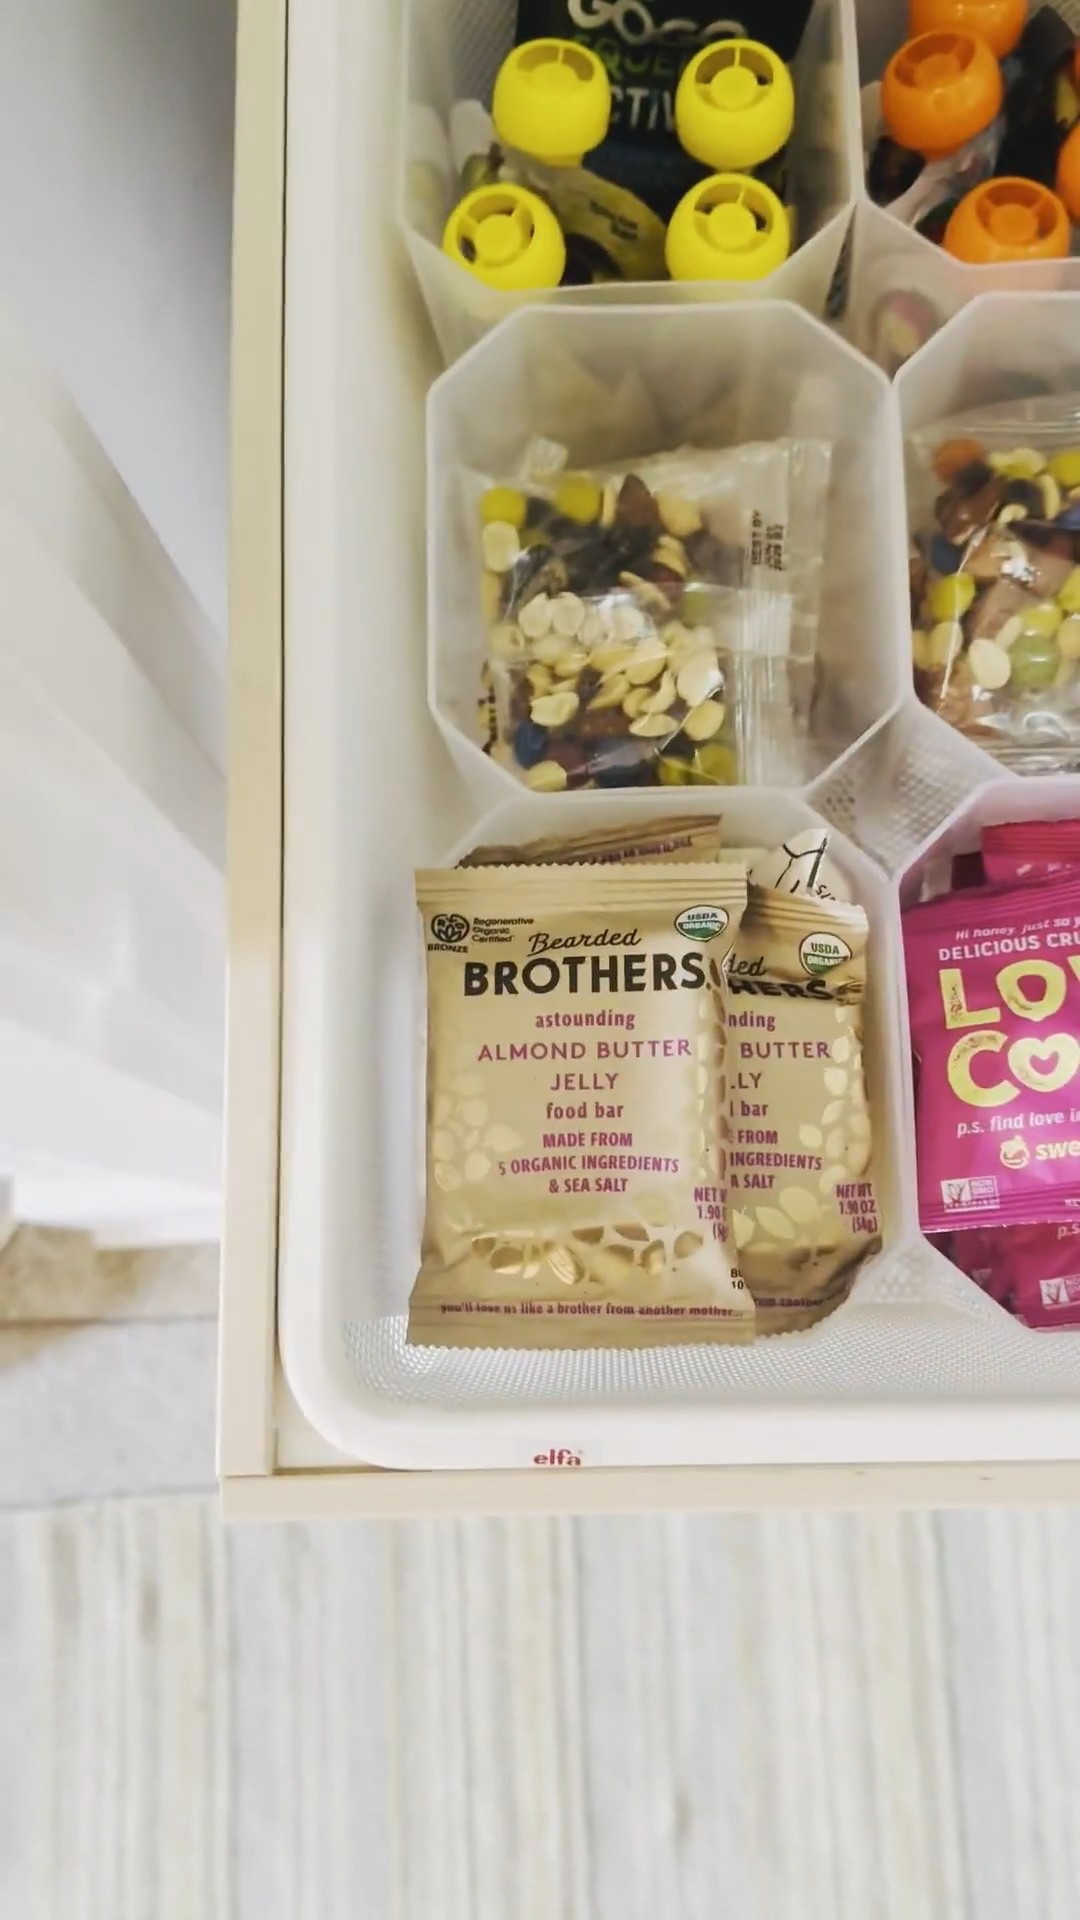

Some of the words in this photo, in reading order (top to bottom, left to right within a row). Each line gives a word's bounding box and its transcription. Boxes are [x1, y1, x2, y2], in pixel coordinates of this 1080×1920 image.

[473, 917, 534, 927] Regenerative
[687, 912, 718, 920] USDA
[472, 926, 510, 935] Organic
[956, 929, 969, 940] Hi
[973, 926, 1015, 938] honey
[1022, 919, 1050, 934] just
[427, 943, 468, 953] BRONZE
[527, 928, 641, 957] Bearded
[810, 942, 840, 955] USDA
[938, 935, 1040, 961] DELICIOUS
[535, 1010, 635, 1030] astounding
[477, 1042, 587, 1061] ALMOND
[597, 1039, 692, 1059] BUTTER
[740, 1042, 830, 1059] BUTTER
[551, 1072, 619, 1091] JELLY
[730, 1072, 762, 1090] LY
[547, 1102, 587, 1119] food
[595, 1101, 624, 1118] bar
[741, 1100, 769, 1117] bar
[957, 1121, 985, 1139] p.s.
[990, 1112, 1024, 1132] find
[1029, 1111, 1065, 1127] love
[543, 1132, 586, 1148] MADE
[591, 1131, 633, 1147] FROM
[738, 1130, 778, 1145] FROM
[498, 1161, 506, 1176] 5
[511, 1156, 576, 1174] ORGANIC
[582, 1155, 680, 1173] INGREDIENTS
[730, 1152, 822, 1171] INGREDIENTS
[548, 1178, 559, 1193] &
[565, 1177, 591, 1192] SEA
[595, 1177, 628, 1192] SALT
[744, 1174, 775, 1189] SALT
[694, 1187, 716, 1202] NET
[836, 1183, 855, 1198] NET
[860, 1199, 876, 1214] OZ
[440, 1301, 473, 1315] you'll
[503, 1304, 518, 1314] us
[521, 1301, 544, 1315] like
[546, 1304, 554, 1314] a
[557, 1301, 602, 1315] brother
[606, 1302, 635, 1315] from
[638, 1304, 685, 1316] another
[533, 1448, 581, 1466] elfa
